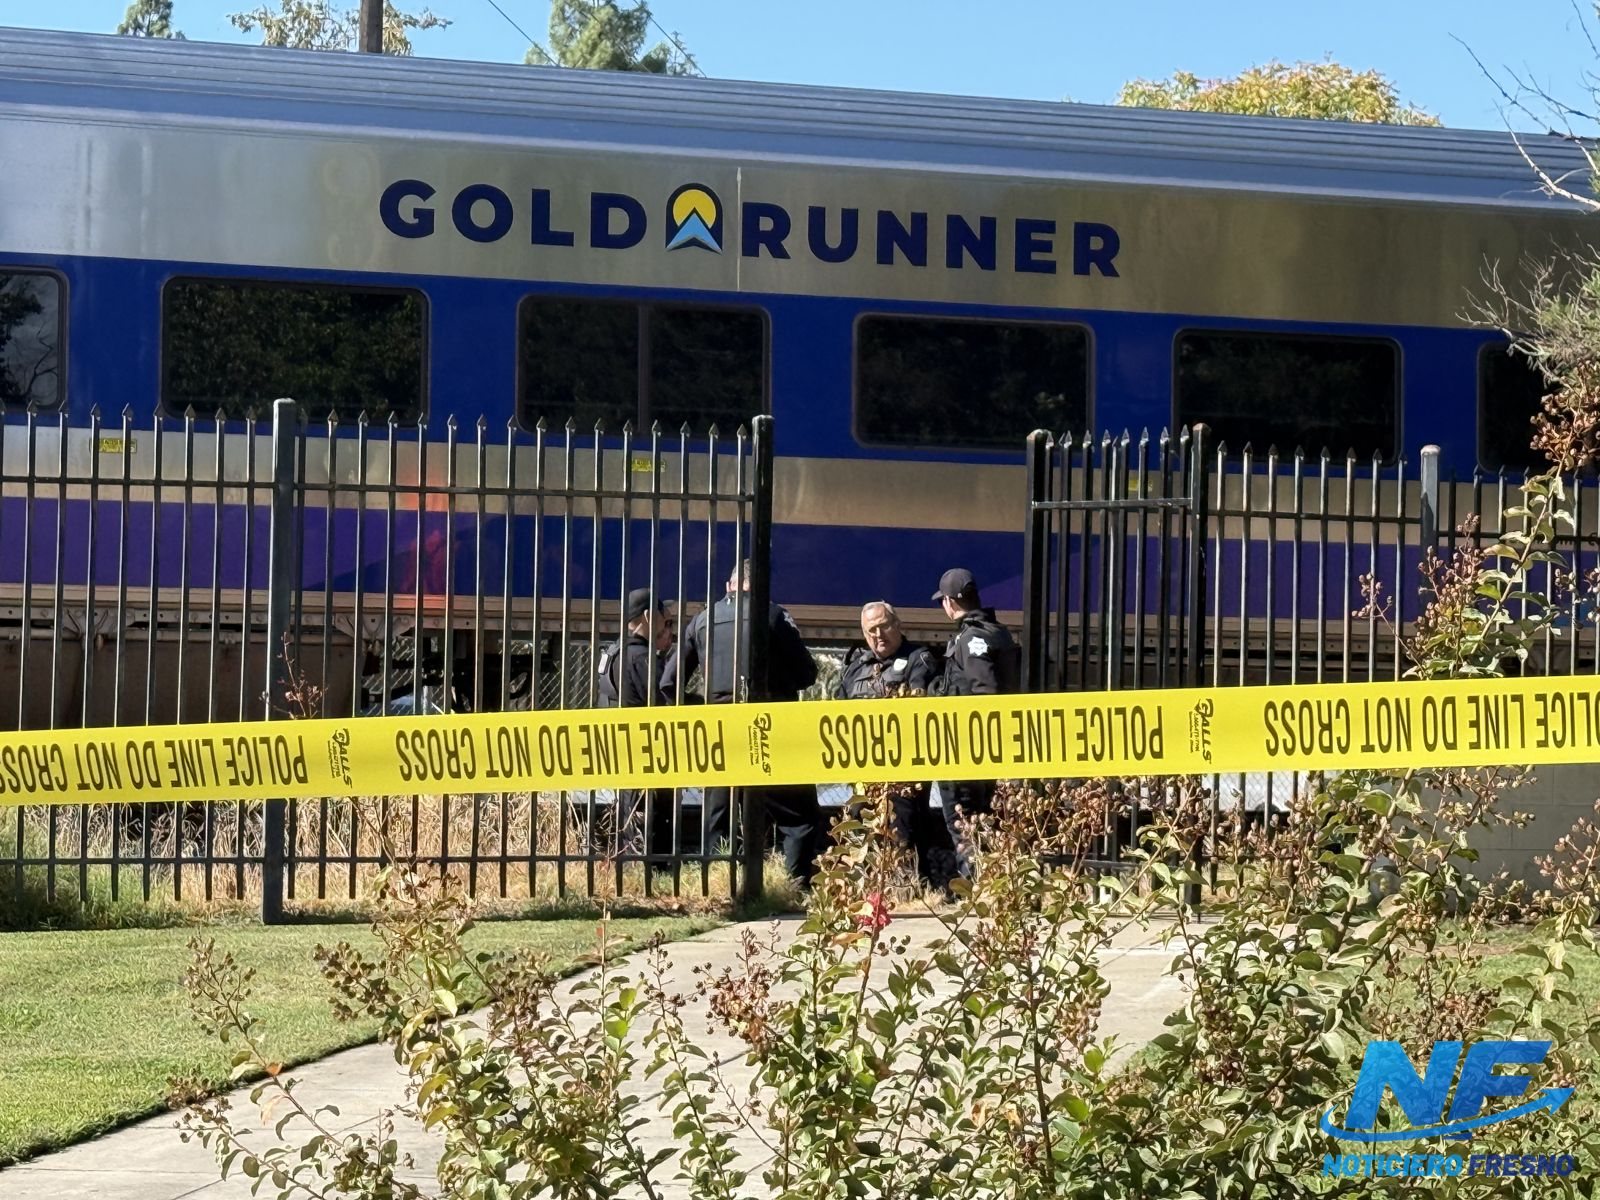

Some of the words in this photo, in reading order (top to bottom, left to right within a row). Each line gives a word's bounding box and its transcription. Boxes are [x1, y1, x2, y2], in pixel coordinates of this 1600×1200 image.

[379, 178, 647, 249] GOLD
[741, 201, 1120, 277] RUNNER
[639, 719, 726, 775] POLICE
[819, 712, 902, 770] CROSS
[911, 711, 960, 767] NOT
[968, 710, 1003, 765] DO
[1011, 708, 1067, 763] LINE
[1074, 705, 1164, 762] POLICE
[1263, 698, 1351, 757] CROSS
[1360, 697, 1412, 753] NOT
[1421, 695, 1458, 752] DO
[1467, 693, 1526, 750] LINE
[1534, 691, 1600, 748] LICE
[74, 742, 123, 792] NOT
[125, 740, 163, 791] DO
[164, 737, 221, 789] LINE
[222, 734, 309, 788] POLICE
[395, 727, 477, 782] CROSS
[485, 726, 533, 779] NOT
[538, 724, 574, 778] DO
[578, 722, 634, 776] LINE
